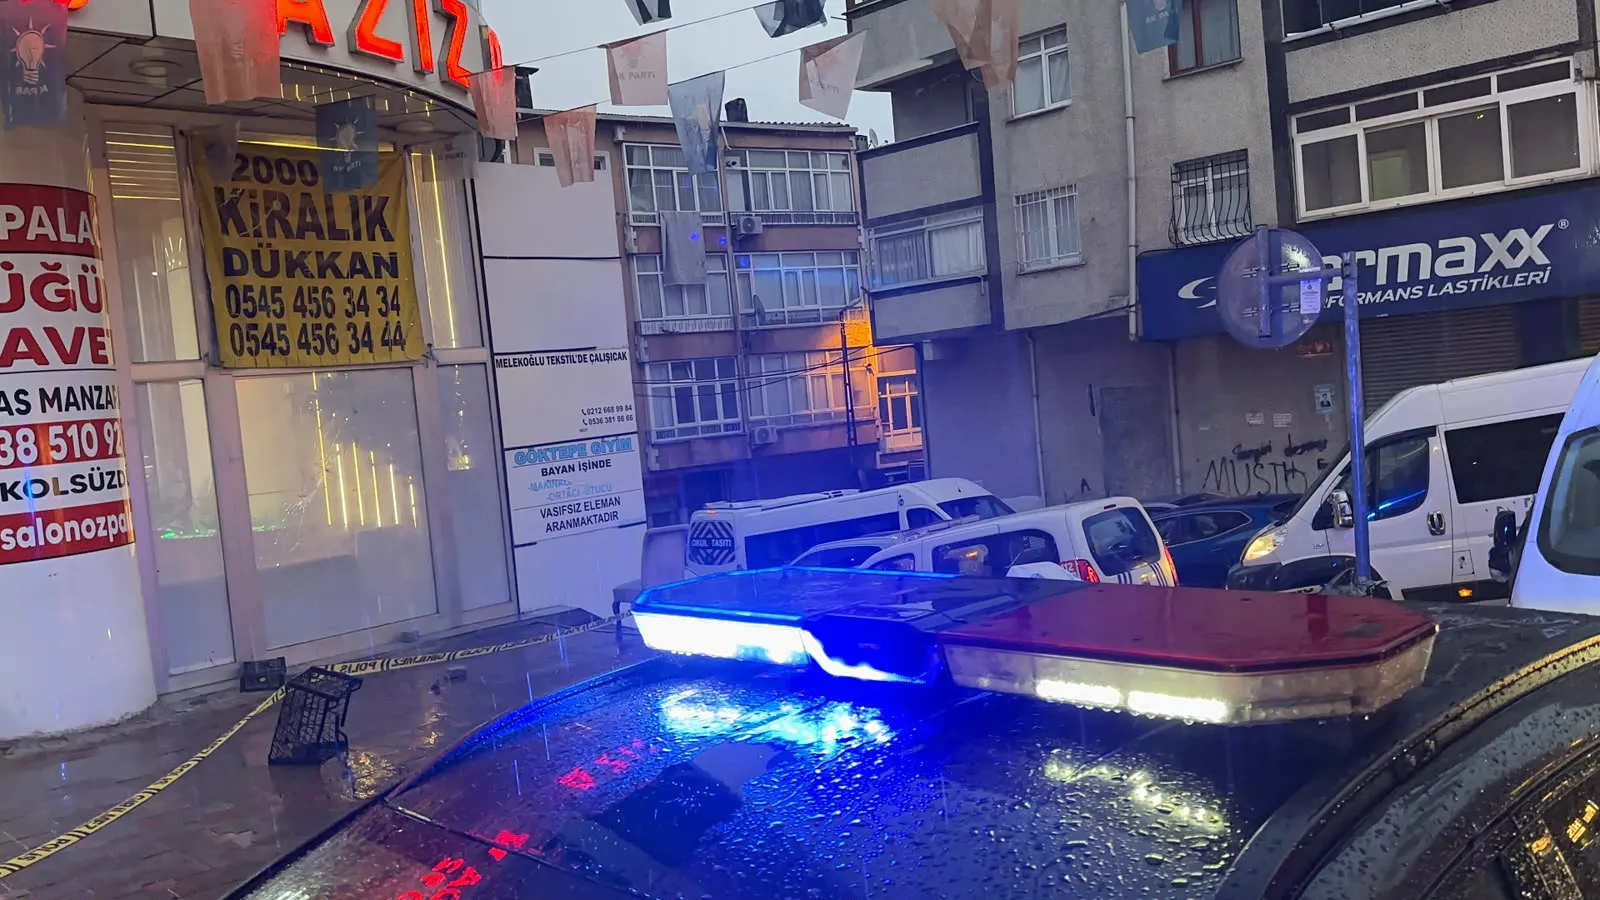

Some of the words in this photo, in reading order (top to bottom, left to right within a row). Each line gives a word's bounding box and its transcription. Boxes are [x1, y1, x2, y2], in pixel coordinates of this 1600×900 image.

[231, 153, 319, 187] 2000
[213, 186, 395, 242] KİRALIK
[222, 243, 399, 279] DÜKKAN
[1427, 267, 1552, 297] LASTİKLERİ
[225, 284, 286, 319] 0545
[292, 286, 336, 319] 456
[342, 285, 370, 318] 34
[376, 285, 401, 318] 34
[229, 322, 291, 357] 0545
[297, 322, 340, 356] 456
[346, 321, 374, 354] 34
[381, 321, 406, 352] 44
[495, 354, 545, 368] MELEKOĞLU
[589, 352, 628, 366] ÇALIŞICAK
[587, 407, 602, 415] 0212
[49, 422, 99, 461] 510
[514, 443, 587, 465] GÖKTEPE
[541, 464, 575, 477] BAYAN
[578, 458, 612, 472] İŞİNDE
[540, 503, 582, 519] VASIFSIZ
[584, 496, 621, 511] ELEMAN
[546, 511, 619, 533] ARANMAKTADIR
